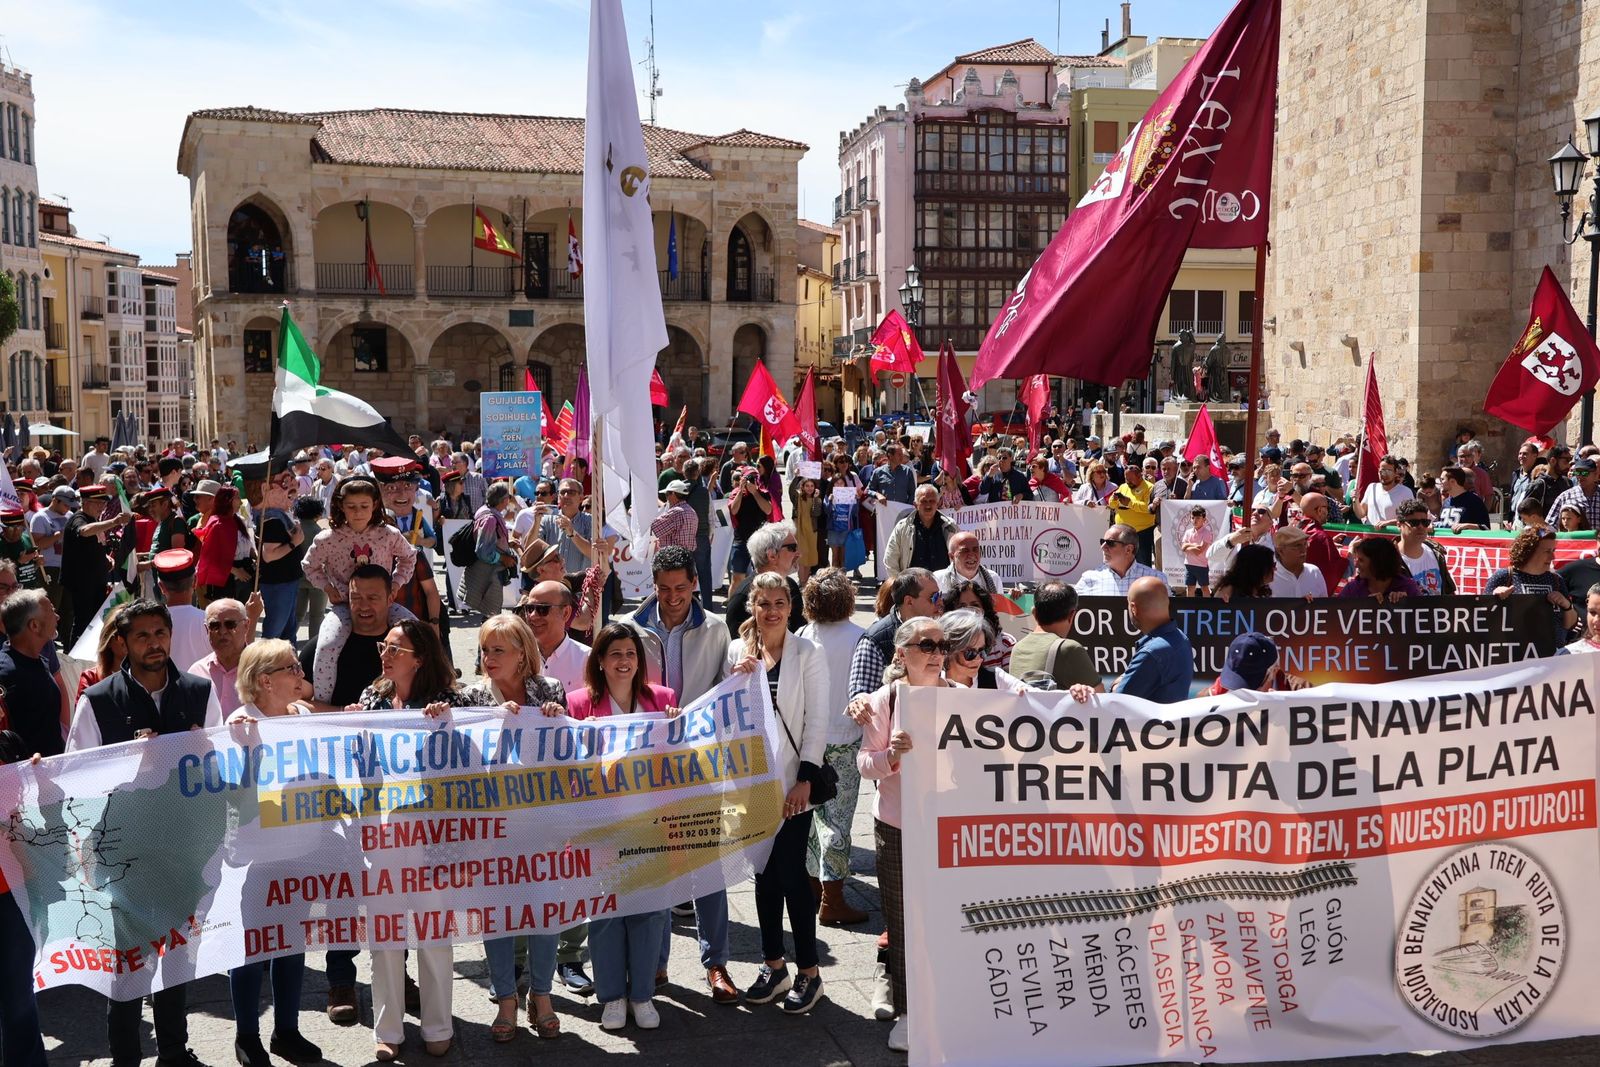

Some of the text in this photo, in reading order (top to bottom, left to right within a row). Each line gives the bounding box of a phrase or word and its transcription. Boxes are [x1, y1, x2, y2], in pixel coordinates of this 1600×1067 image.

[486, 412, 537, 422] SORIHUELA
[488, 396, 535, 405] GUIJUELO
[503, 461, 528, 469] PLATA
[975, 528, 987, 541] DE
[989, 527, 1000, 541] LA
[1003, 526, 1033, 540] PLATA!
[1002, 506, 1019, 520] POR
[1022, 506, 1032, 519] EL
[1035, 507, 1060, 521] TREN
[1440, 508, 1462, 524] 95
[999, 545, 1016, 559] POR
[1074, 609, 1114, 636] OR
[1123, 609, 1141, 636] U
[1176, 608, 1256, 635] TREN
[1265, 609, 1328, 639] QUE
[178, 688, 755, 798] CONCENTRACIÓN EN TODO EL OESTE
[937, 678, 1595, 755] ASOCIACIÓN BENAVENTANA
[294, 782, 433, 822] RECUPERAR
[441, 776, 500, 810] TREN
[503, 770, 565, 806] RUTA
[567, 768, 597, 798] DE
[600, 761, 629, 792] LA
[632, 753, 703, 790] PLATA
[705, 745, 738, 778] YA
[984, 735, 1560, 803] TREN RUTA DE LA PLATA
[362, 816, 507, 852] BENAVENTE
[668, 827, 721, 840] 643 92 03 92
[679, 817, 714, 828] territorio
[692, 808, 725, 819] convocar
[952, 788, 1586, 867] ¡NECESITAMOS NUESTRO TREN, ES NUESTRO FUTURO!!
[266, 847, 591, 907] APOYA LA RECUPERACIÓN
[50, 943, 145, 974] SÚBETE
[150, 927, 188, 958] YA
[244, 893, 618, 958] DEL TREN DE VIA DE LA PLATA
[1206, 912, 1235, 1006] ZAMORA
[1299, 908, 1317, 966] LEÓN
[1326, 898, 1346, 965] GIJÓN
[1403, 849, 1560, 1031] ASOCIACIÓN BENAVENTANA TREN RUTA DE LA PLATA
[985, 947, 1013, 1019] CÁDIZ
[1017, 942, 1048, 1037] SEVILLA
[1049, 937, 1076, 1010] ZAFRA
[1081, 934, 1111, 1017] MÉRIDA
[1114, 927, 1147, 1030] CÁCERES
[1147, 923, 1184, 1048] PLASENCIA
[1178, 919, 1217, 1058] SALAMANCA
[1237, 911, 1272, 1031] BENAVENTE
[1267, 911, 1298, 1013] ASTORGA
